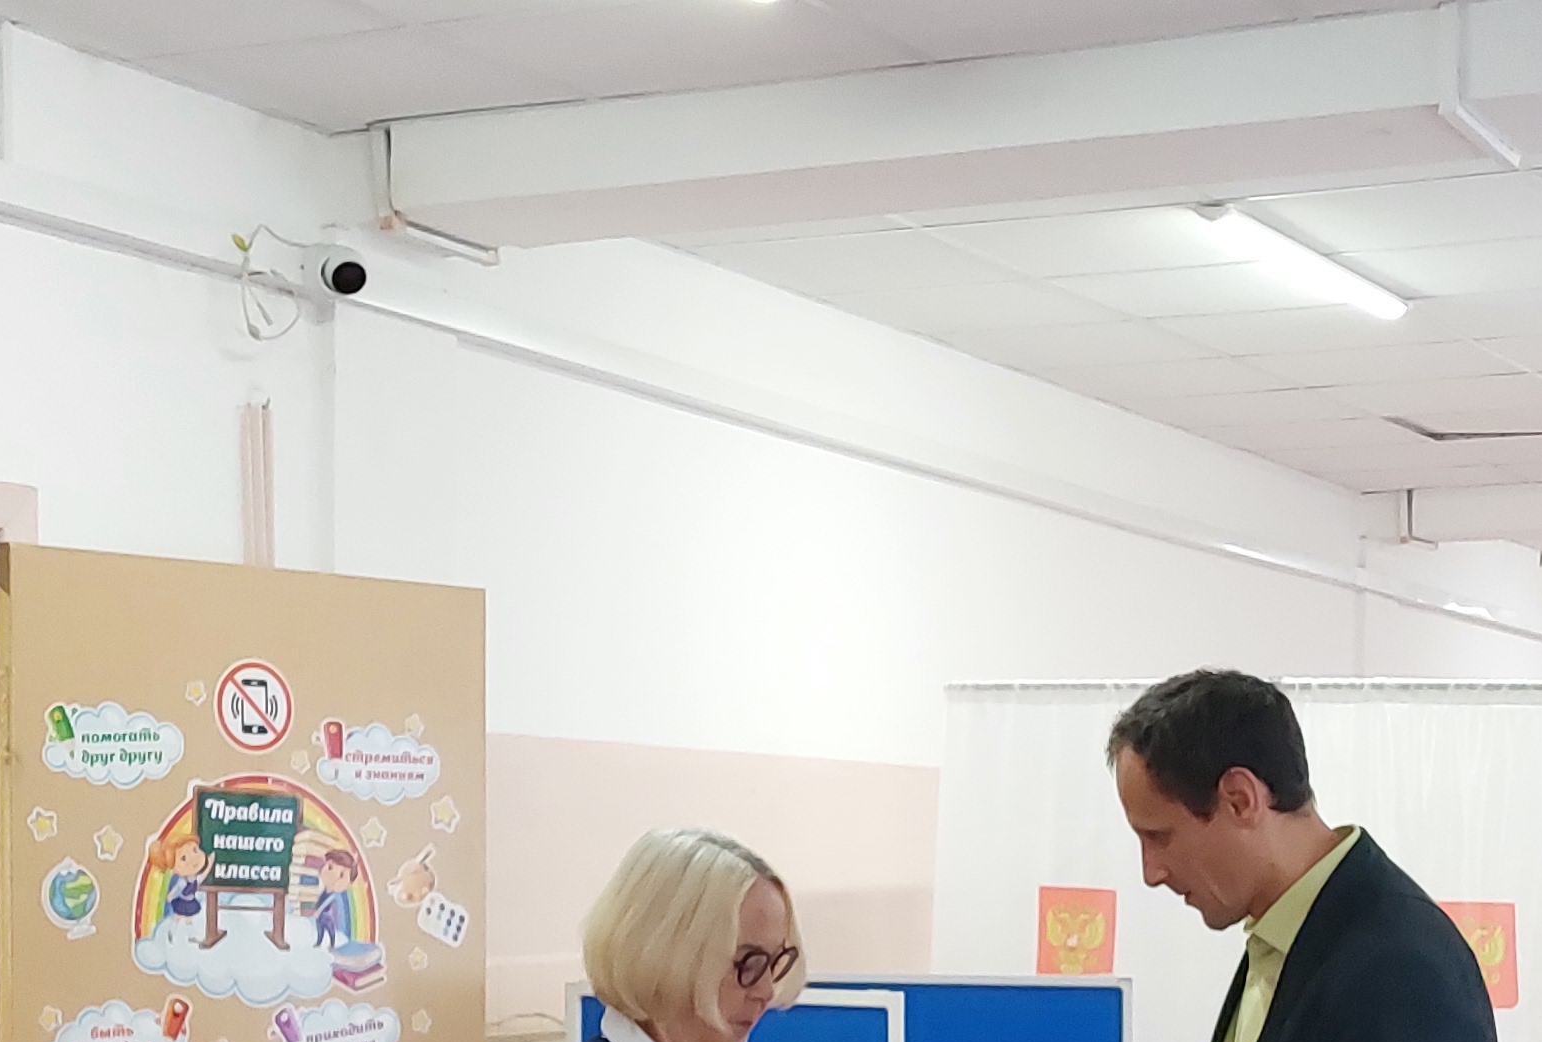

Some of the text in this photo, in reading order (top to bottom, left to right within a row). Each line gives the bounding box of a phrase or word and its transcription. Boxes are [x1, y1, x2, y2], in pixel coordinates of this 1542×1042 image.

[81, 728, 160, 743] помогать
[82, 748, 163, 766] друг другу
[205, 798, 293, 824] Правила
[213, 834, 285, 852] нашего
[215, 863, 281, 881] класса
[91, 1024, 134, 1039] быть
